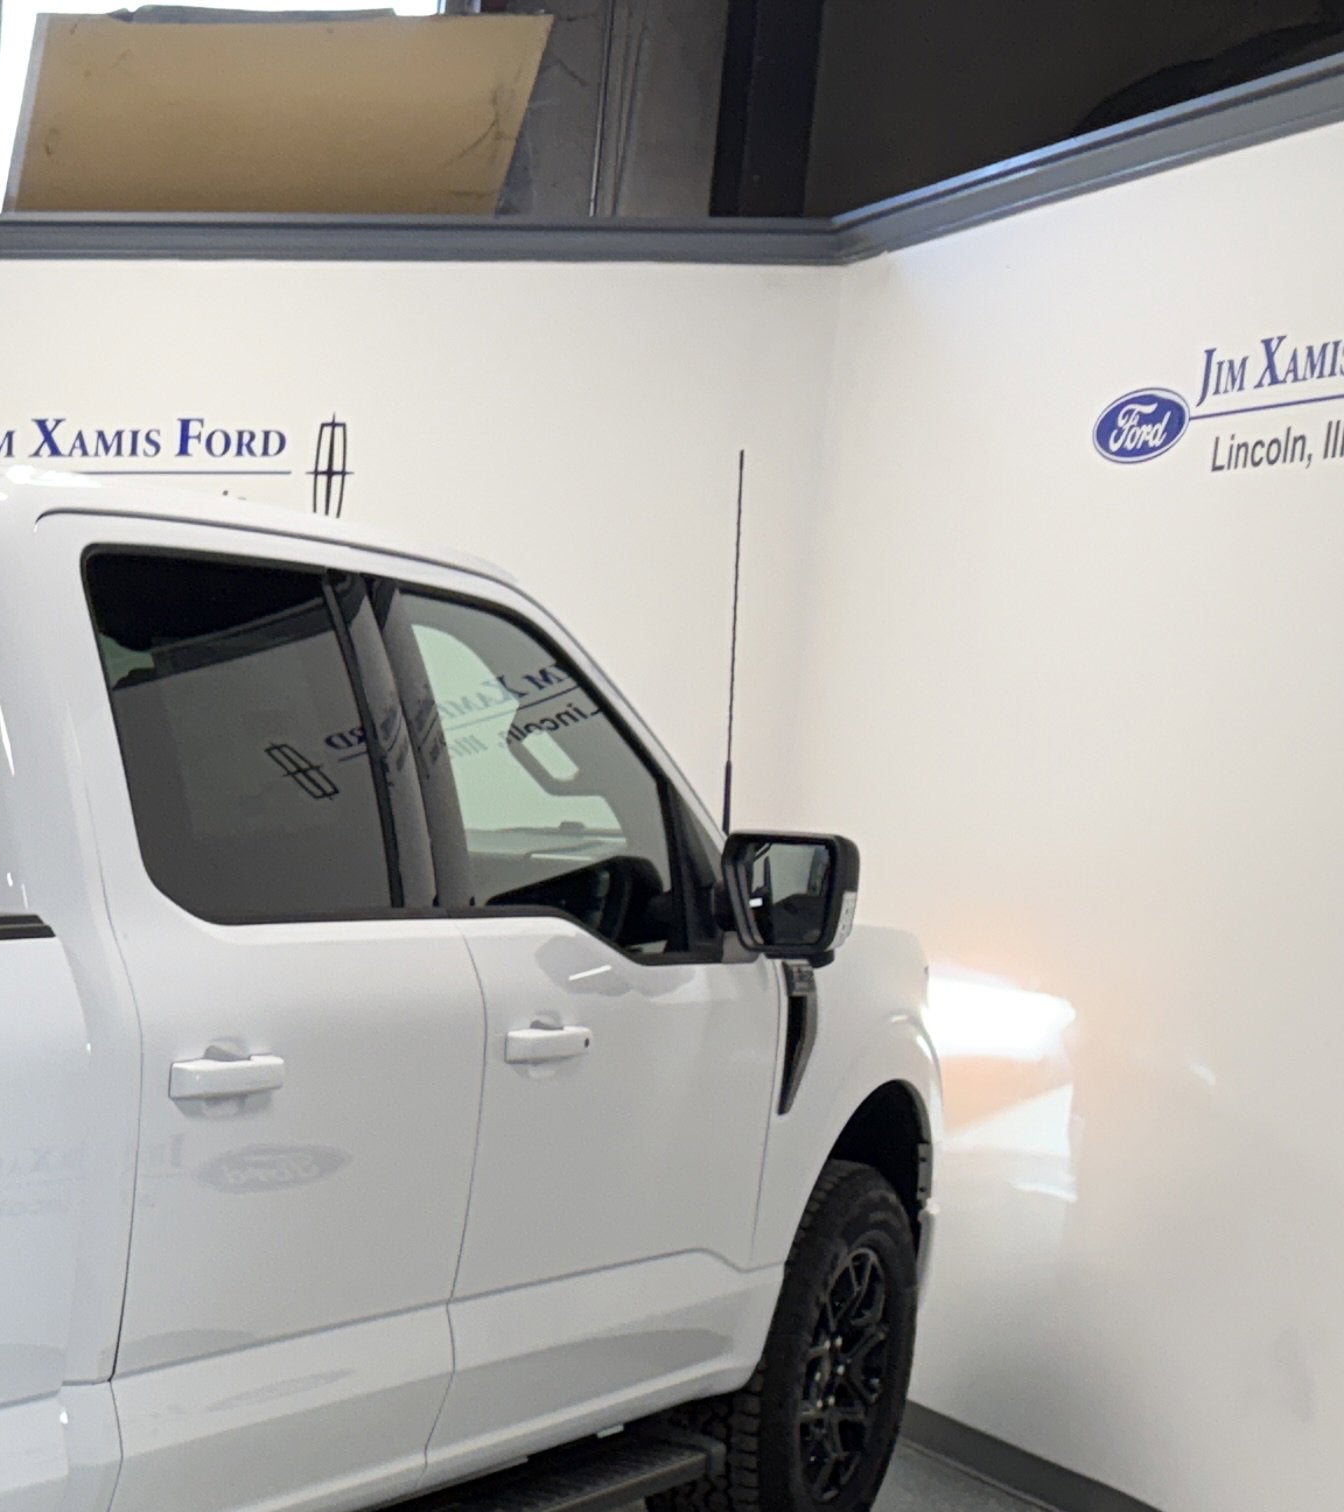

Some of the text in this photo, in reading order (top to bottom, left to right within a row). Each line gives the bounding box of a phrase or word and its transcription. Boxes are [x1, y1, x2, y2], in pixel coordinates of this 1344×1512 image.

[1196, 348, 1249, 407] JIM
[28, 418, 162, 458] XAMIS
[174, 418, 287, 458] FORD
[1109, 402, 1171, 453] Ford
[1211, 426, 1313, 472] Lincoln,
